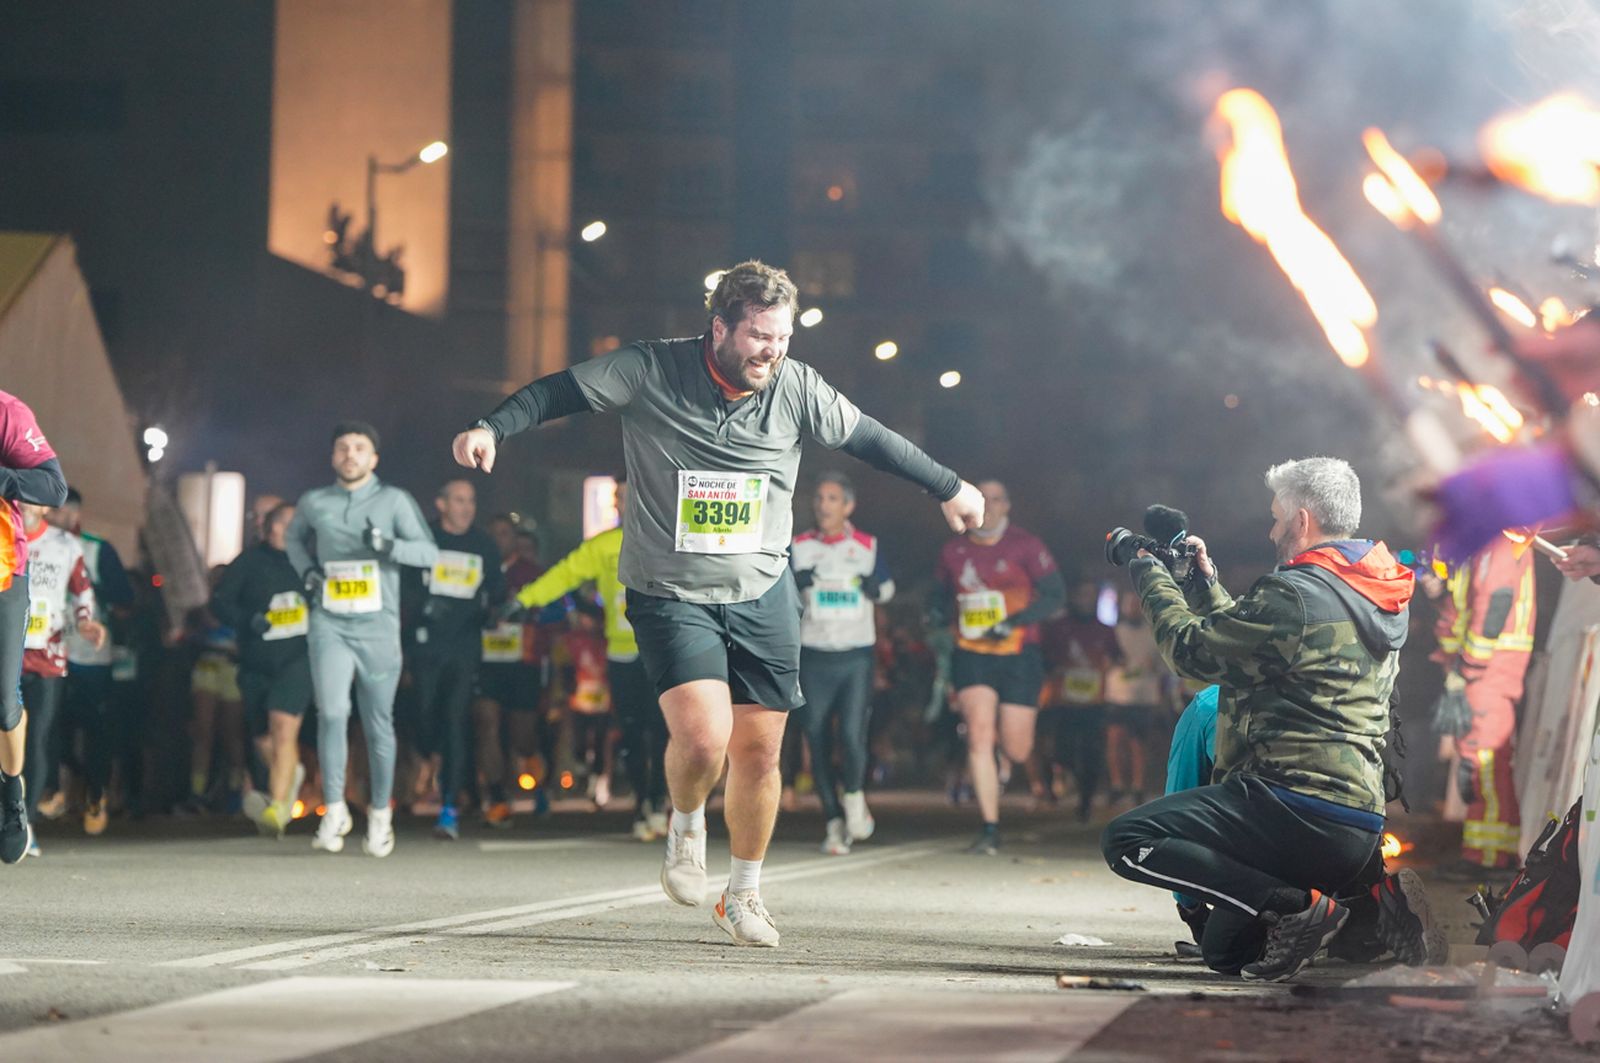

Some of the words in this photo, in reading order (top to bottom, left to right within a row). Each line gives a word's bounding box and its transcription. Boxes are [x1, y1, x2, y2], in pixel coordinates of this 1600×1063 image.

[699, 481, 725, 489] NOCHE
[727, 481, 736, 489] DE
[688, 489, 706, 499] SAN
[693, 501, 750, 525] 3394
